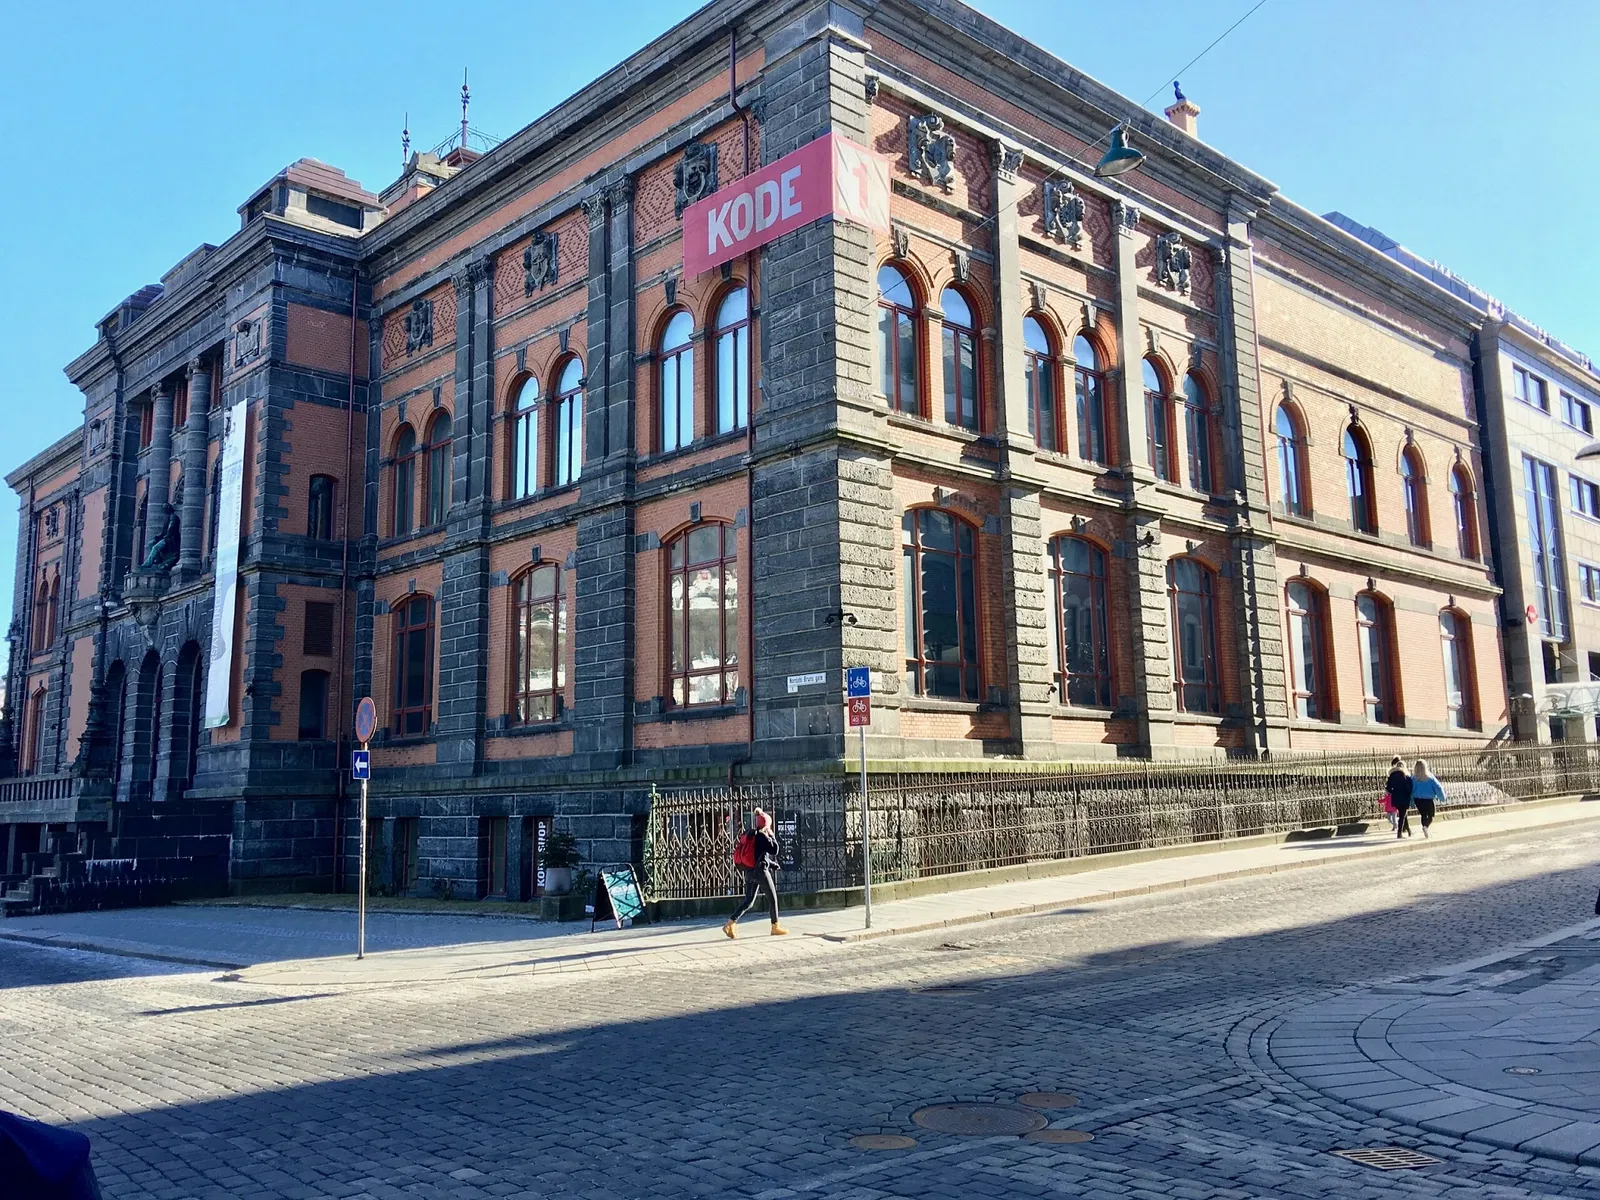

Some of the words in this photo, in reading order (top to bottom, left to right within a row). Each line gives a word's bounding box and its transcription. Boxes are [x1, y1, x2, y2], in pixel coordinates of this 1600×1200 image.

[708, 164, 802, 256] KODE
[852, 162, 870, 211] 1
[815, 675, 823, 683] gate
[538, 821, 546, 853] SHOP
